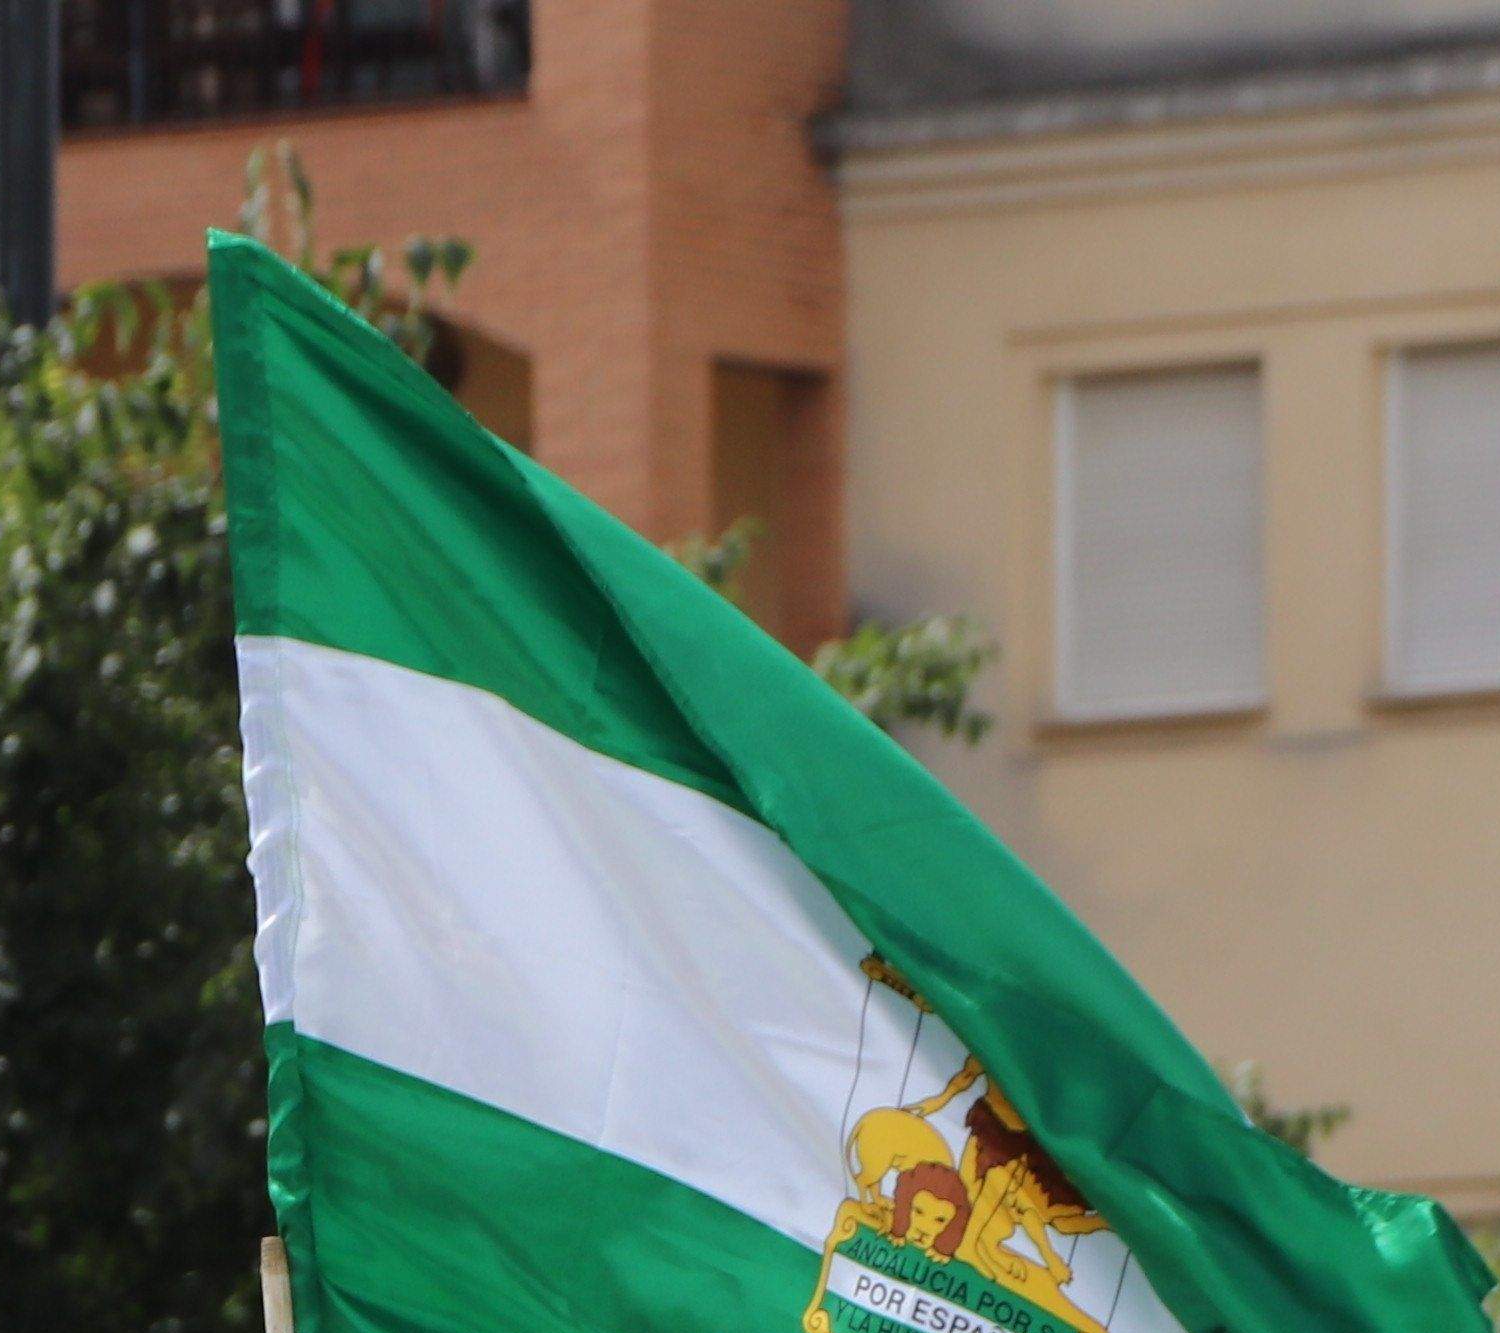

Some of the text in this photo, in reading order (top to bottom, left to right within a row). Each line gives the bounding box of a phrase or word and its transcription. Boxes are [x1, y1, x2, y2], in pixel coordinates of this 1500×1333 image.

[846, 1238, 968, 1303] ANDALUCIA
[835, 1299, 849, 1322] Y
[853, 1275, 906, 1314] POR
